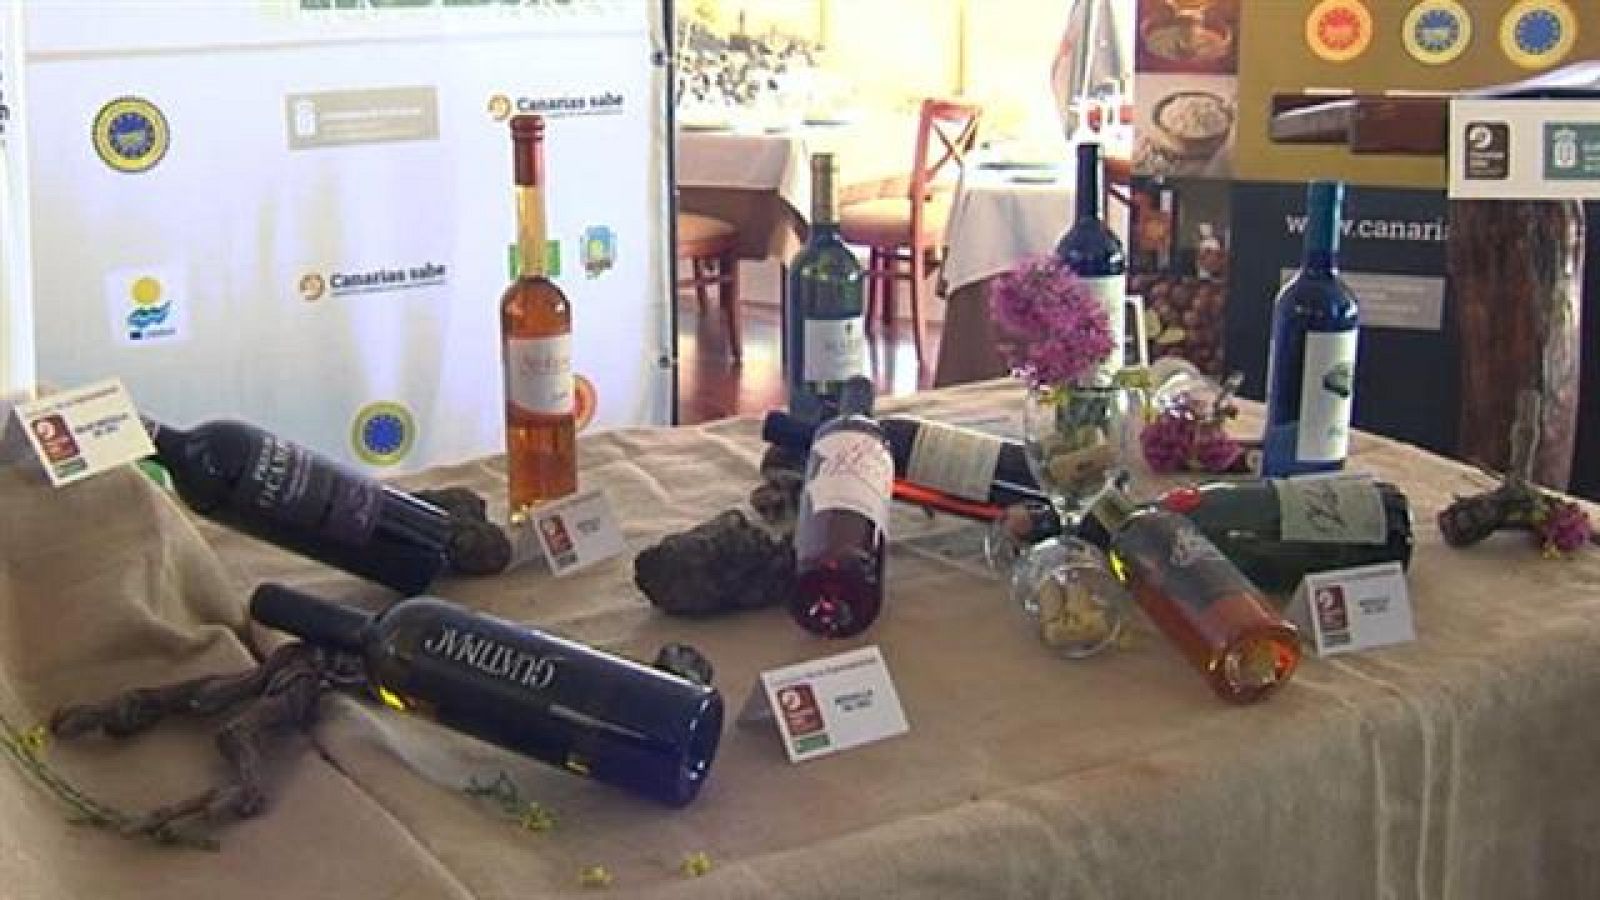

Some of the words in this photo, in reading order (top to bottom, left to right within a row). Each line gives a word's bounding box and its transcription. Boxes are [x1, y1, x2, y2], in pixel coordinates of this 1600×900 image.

[516, 96, 586, 111] Canarias
[589, 91, 624, 106] sabe
[330, 269, 406, 288] Canarias
[410, 261, 446, 280] sabe
